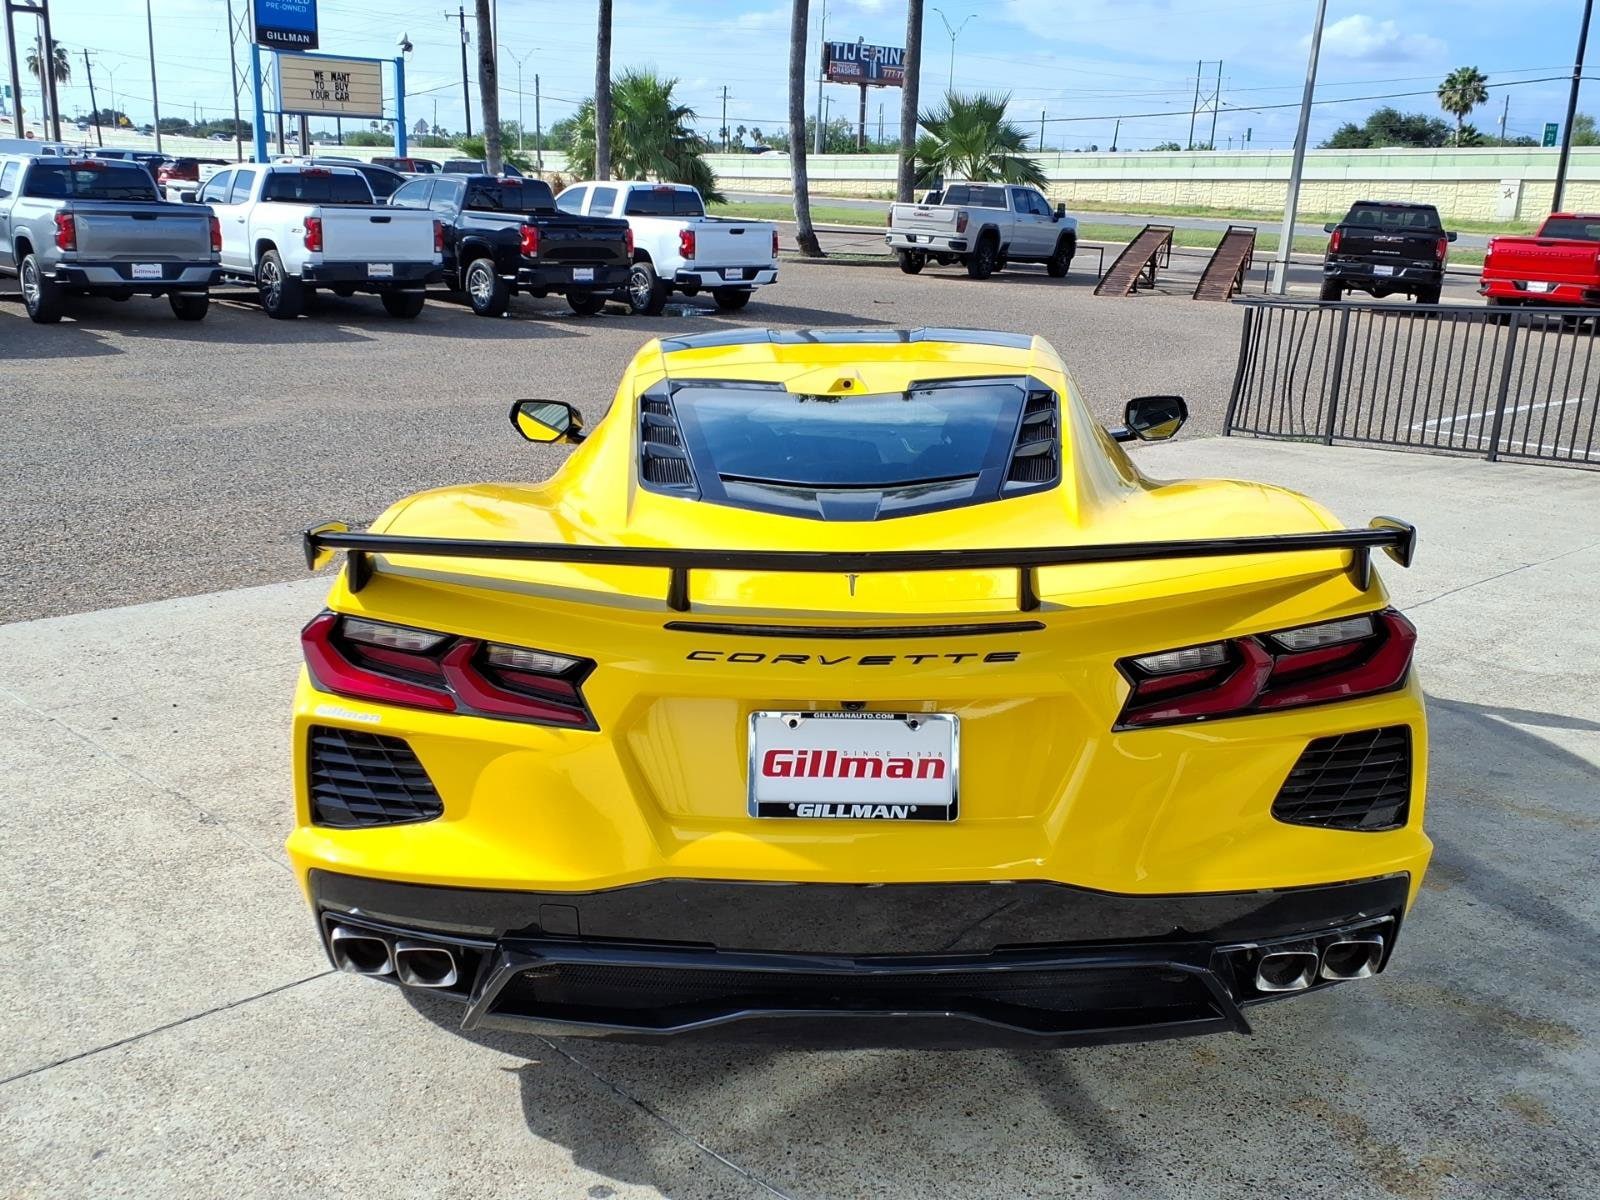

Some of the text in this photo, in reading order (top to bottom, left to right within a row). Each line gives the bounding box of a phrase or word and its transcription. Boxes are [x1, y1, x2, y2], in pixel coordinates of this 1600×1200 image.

[265, 1, 307, 13] PRE-OWNED
[266, 31, 310, 43] GILLMAN
[832, 43, 906, 65] TIJERIN
[313, 70, 351, 82] WE WANT
[883, 69, 904, 78] 777-77
[315, 81, 349, 91] TO BUY
[310, 89, 350, 102] YOUR CAR
[686, 650, 1021, 666] CORVETTE
[762, 749, 946, 779] Gillman
[796, 803, 908, 819] GILLMAN
